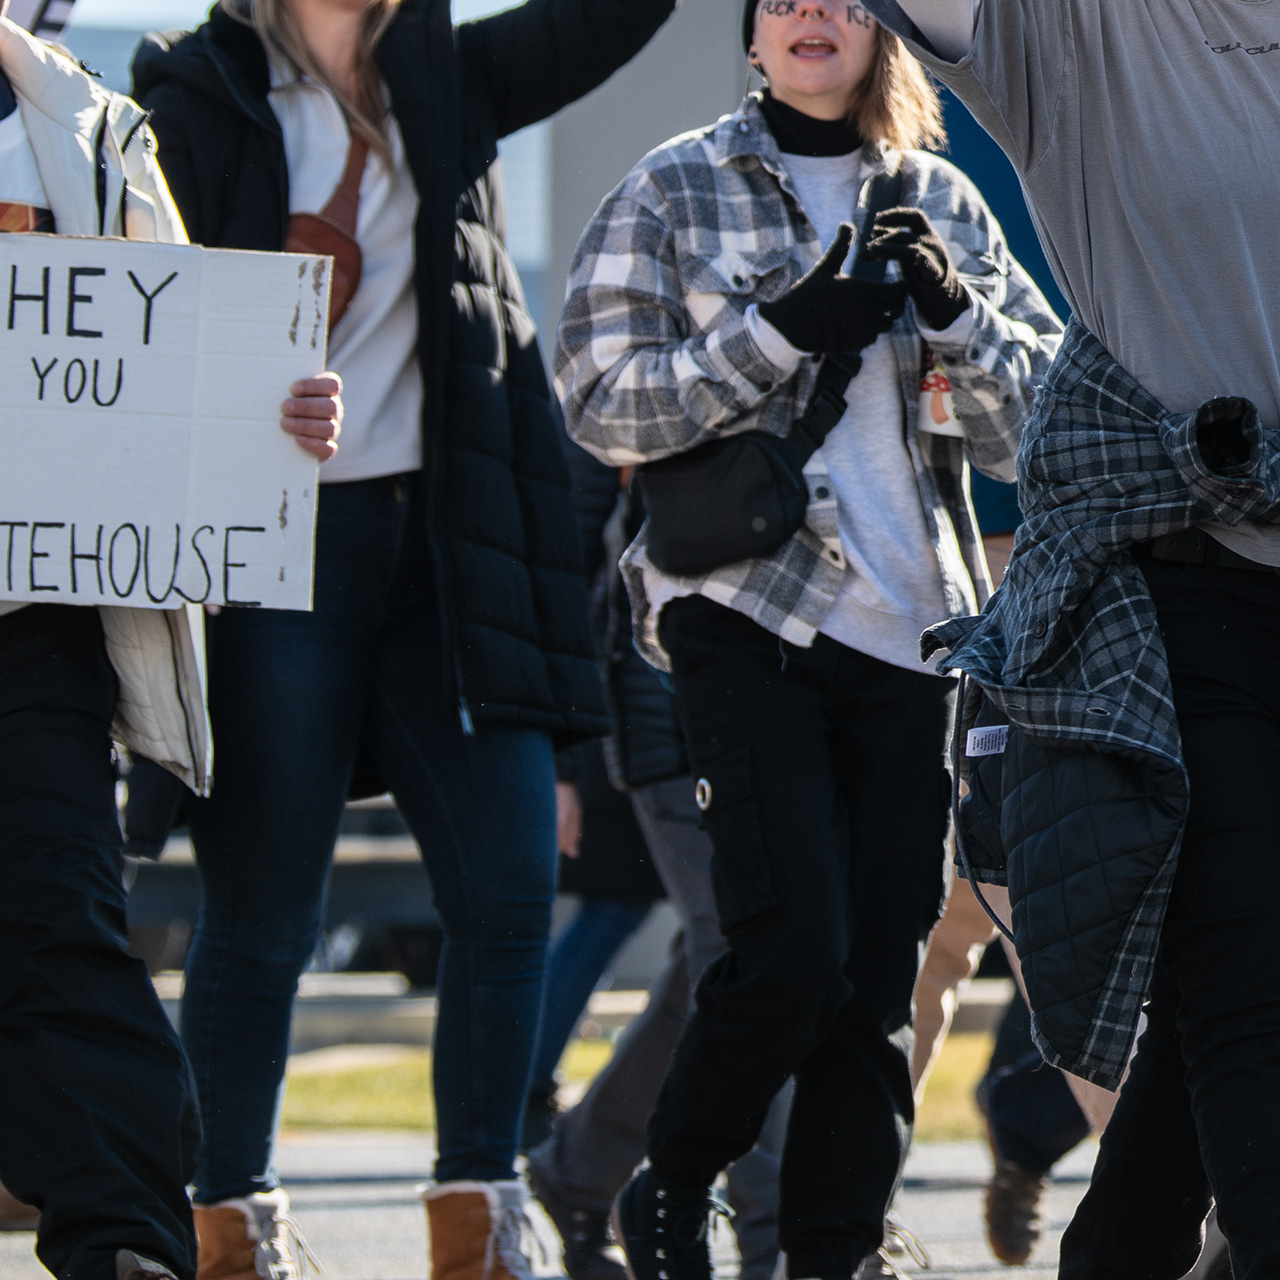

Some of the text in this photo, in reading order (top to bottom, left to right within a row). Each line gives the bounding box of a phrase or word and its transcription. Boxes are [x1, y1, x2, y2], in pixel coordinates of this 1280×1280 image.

[760, 0, 798, 21] FUCK
[7, 263, 179, 346] HEY
[30, 356, 125, 408] YOU
